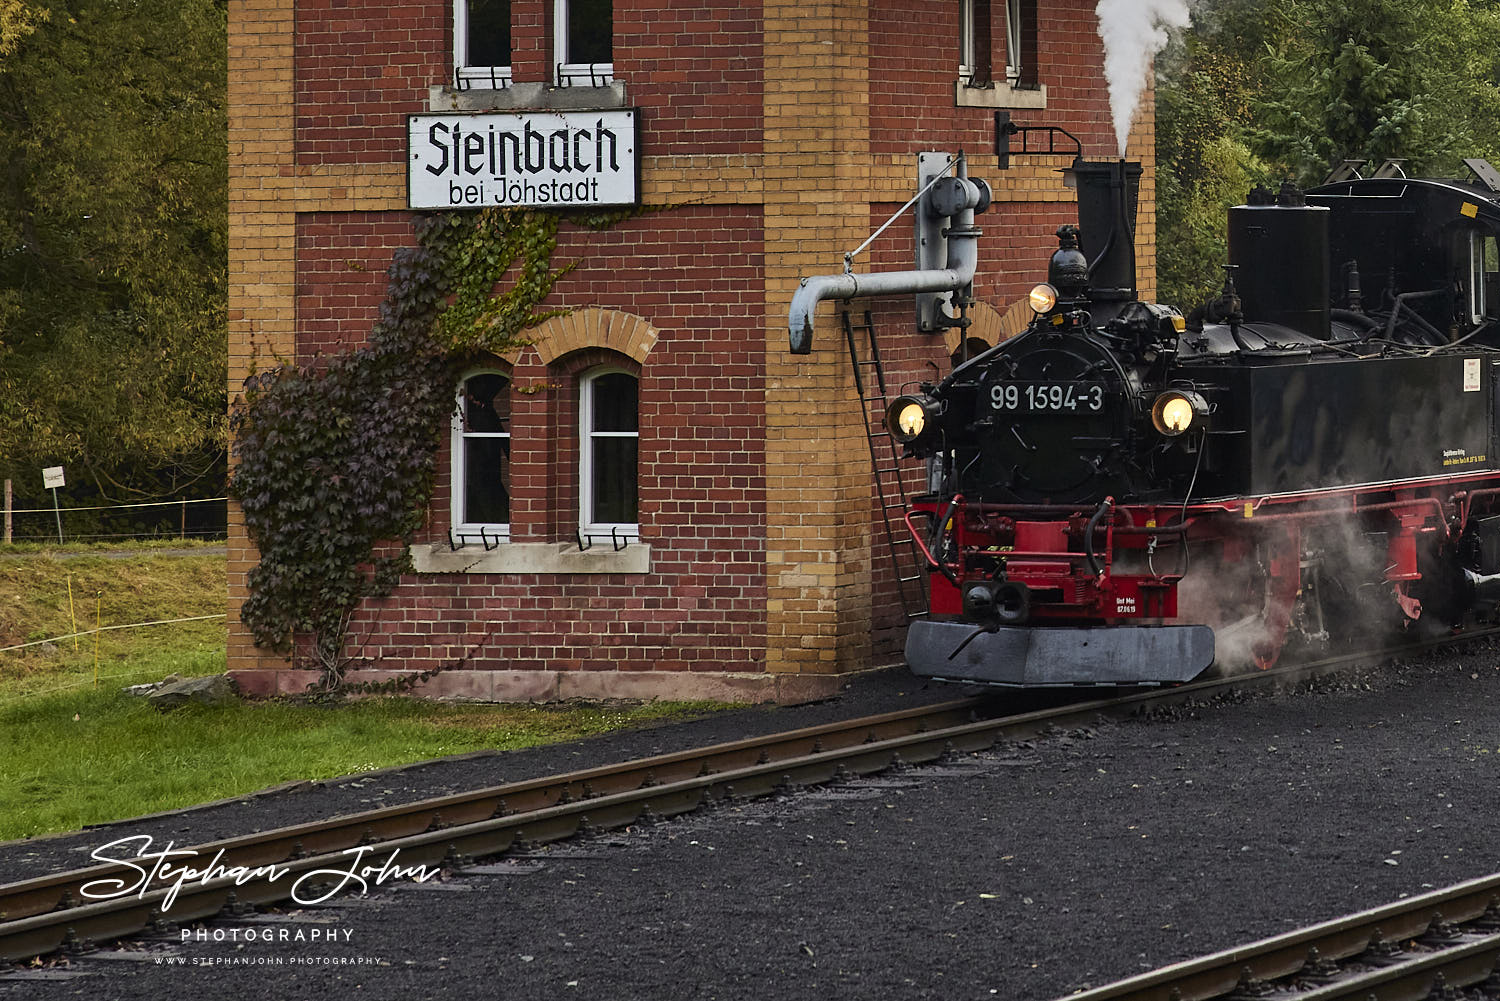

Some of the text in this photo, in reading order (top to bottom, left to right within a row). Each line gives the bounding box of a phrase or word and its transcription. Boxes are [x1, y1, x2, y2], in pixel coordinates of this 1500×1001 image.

[425, 117, 620, 177] Steinbach
[449, 177, 599, 205] bei Jöhstadt
[990, 385, 1104, 411] 99 1594-3
